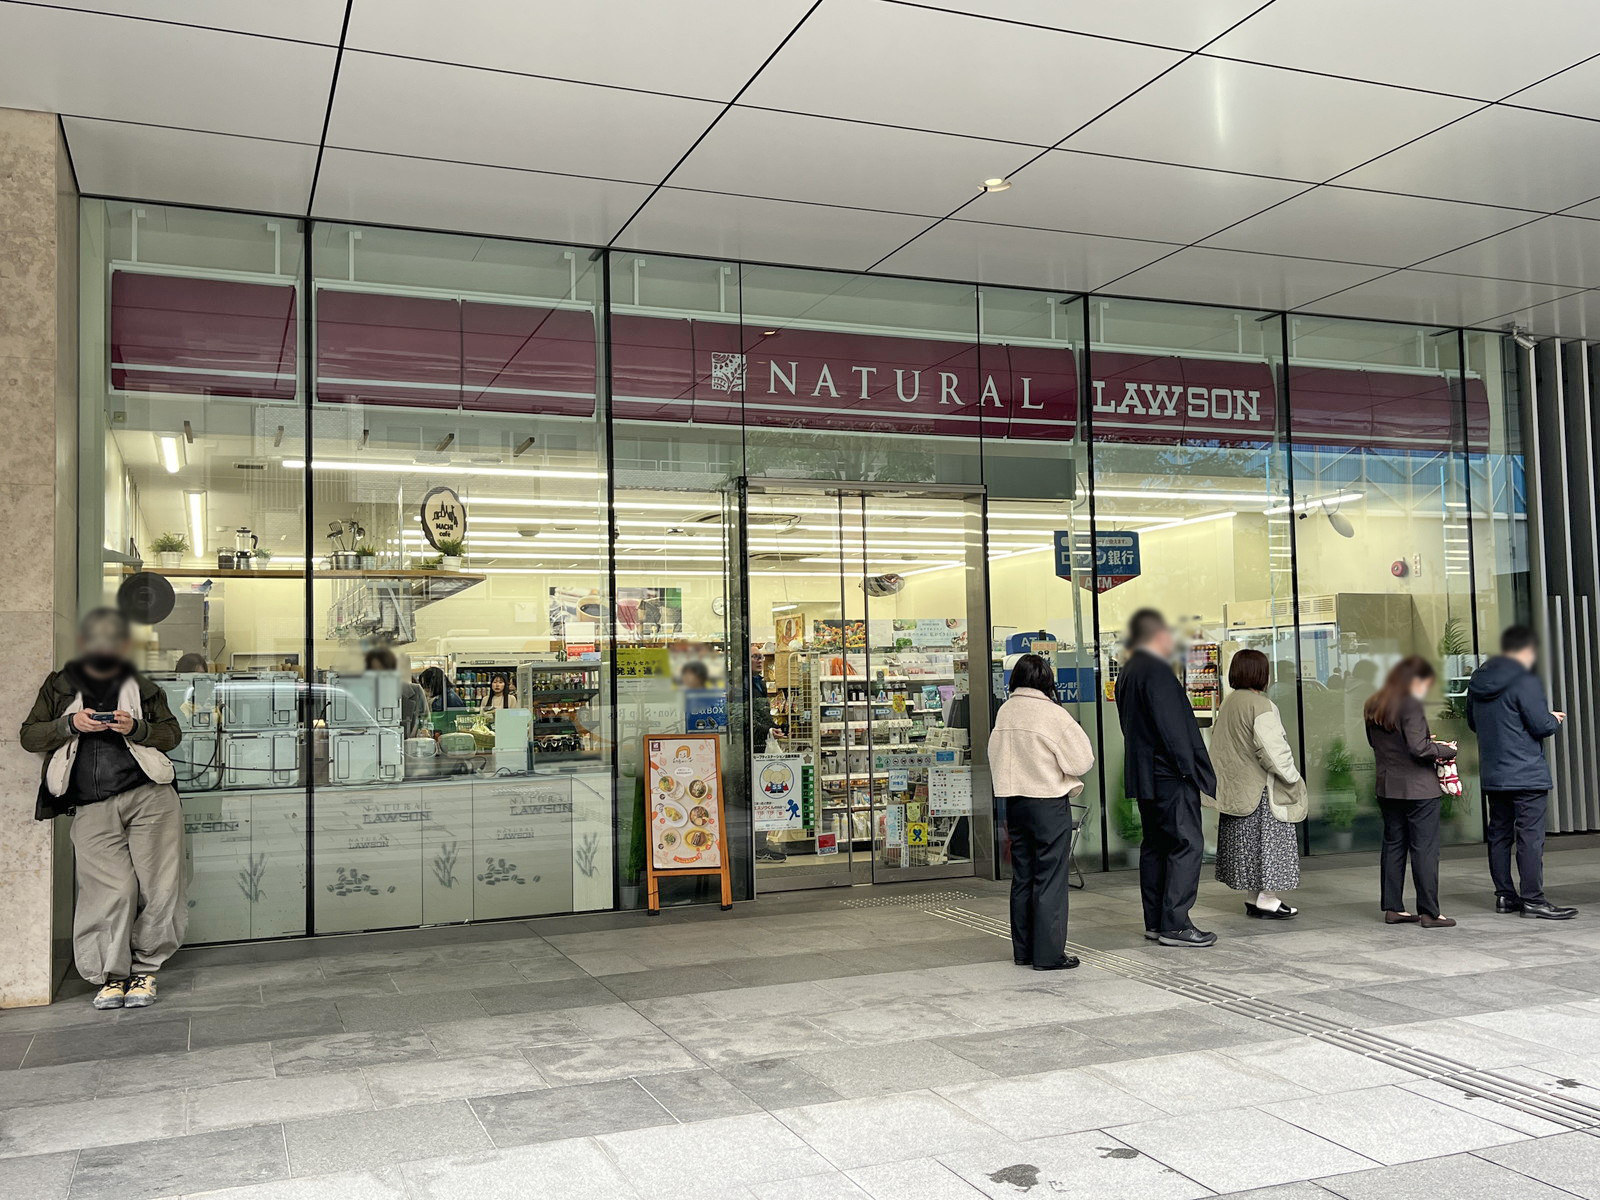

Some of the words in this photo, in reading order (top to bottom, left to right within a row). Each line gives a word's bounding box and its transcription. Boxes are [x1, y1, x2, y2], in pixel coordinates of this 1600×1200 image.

[767, 359, 1044, 410] NATURAL
[1092, 380, 1261, 422] LAWSON
[435, 522, 454, 531] MACHI
[362, 811, 433, 825] LAWSON
